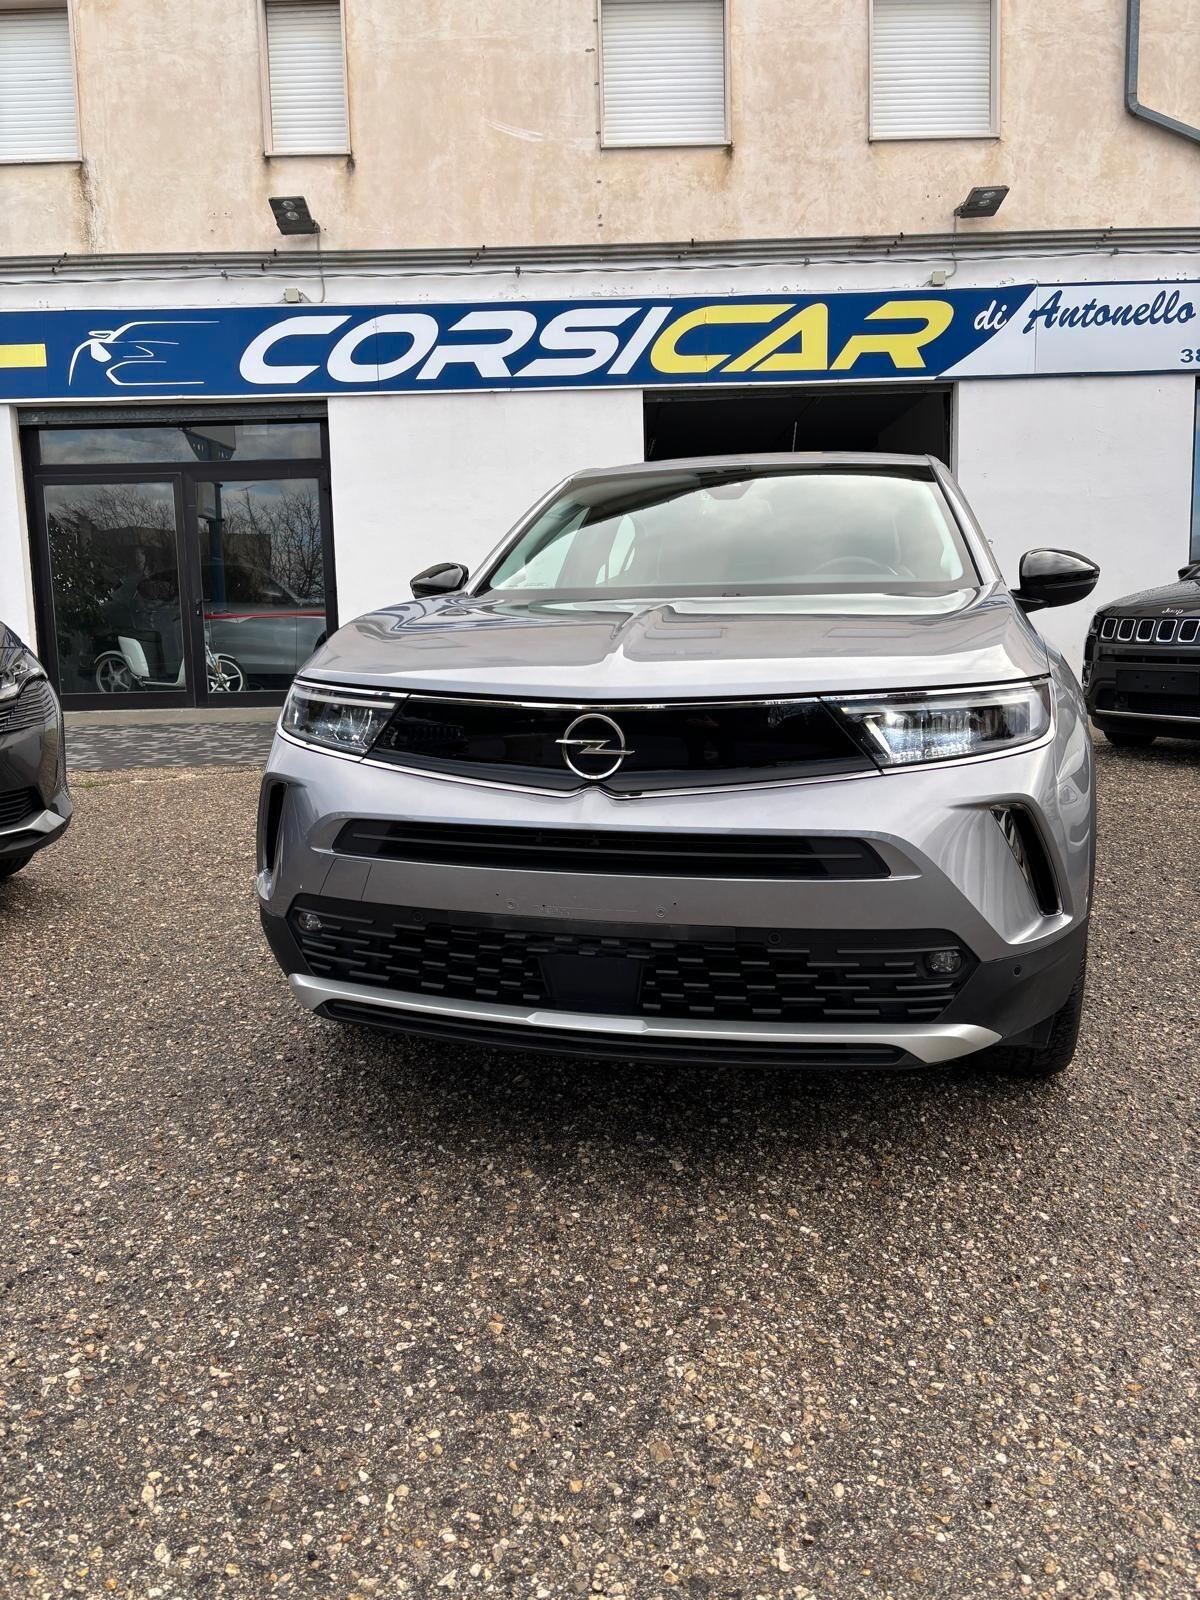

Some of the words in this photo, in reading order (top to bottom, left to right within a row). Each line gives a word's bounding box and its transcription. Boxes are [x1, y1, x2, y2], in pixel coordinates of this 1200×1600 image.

[239, 300, 954, 384] CORSICAR
[974, 300, 1008, 330] di
[1022, 290, 1196, 334] Antonello
